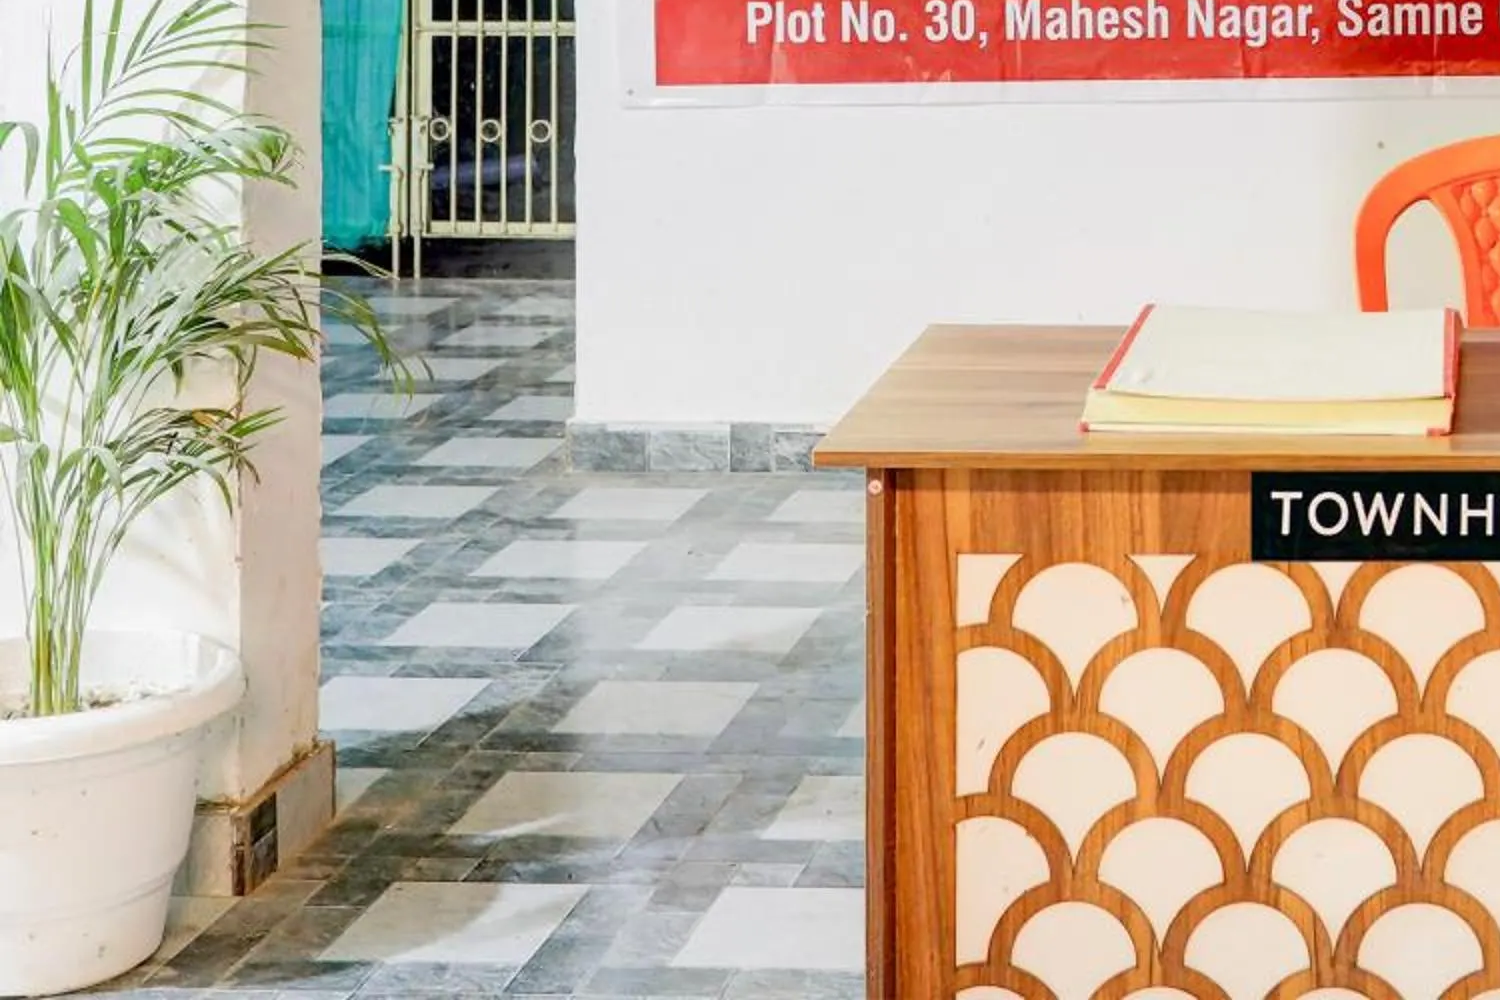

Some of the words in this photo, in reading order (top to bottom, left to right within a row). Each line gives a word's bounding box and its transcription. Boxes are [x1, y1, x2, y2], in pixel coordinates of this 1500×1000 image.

[746, 2, 826, 44] Plot
[841, 1, 908, 42] No.
[925, 0, 988, 47] 30,
